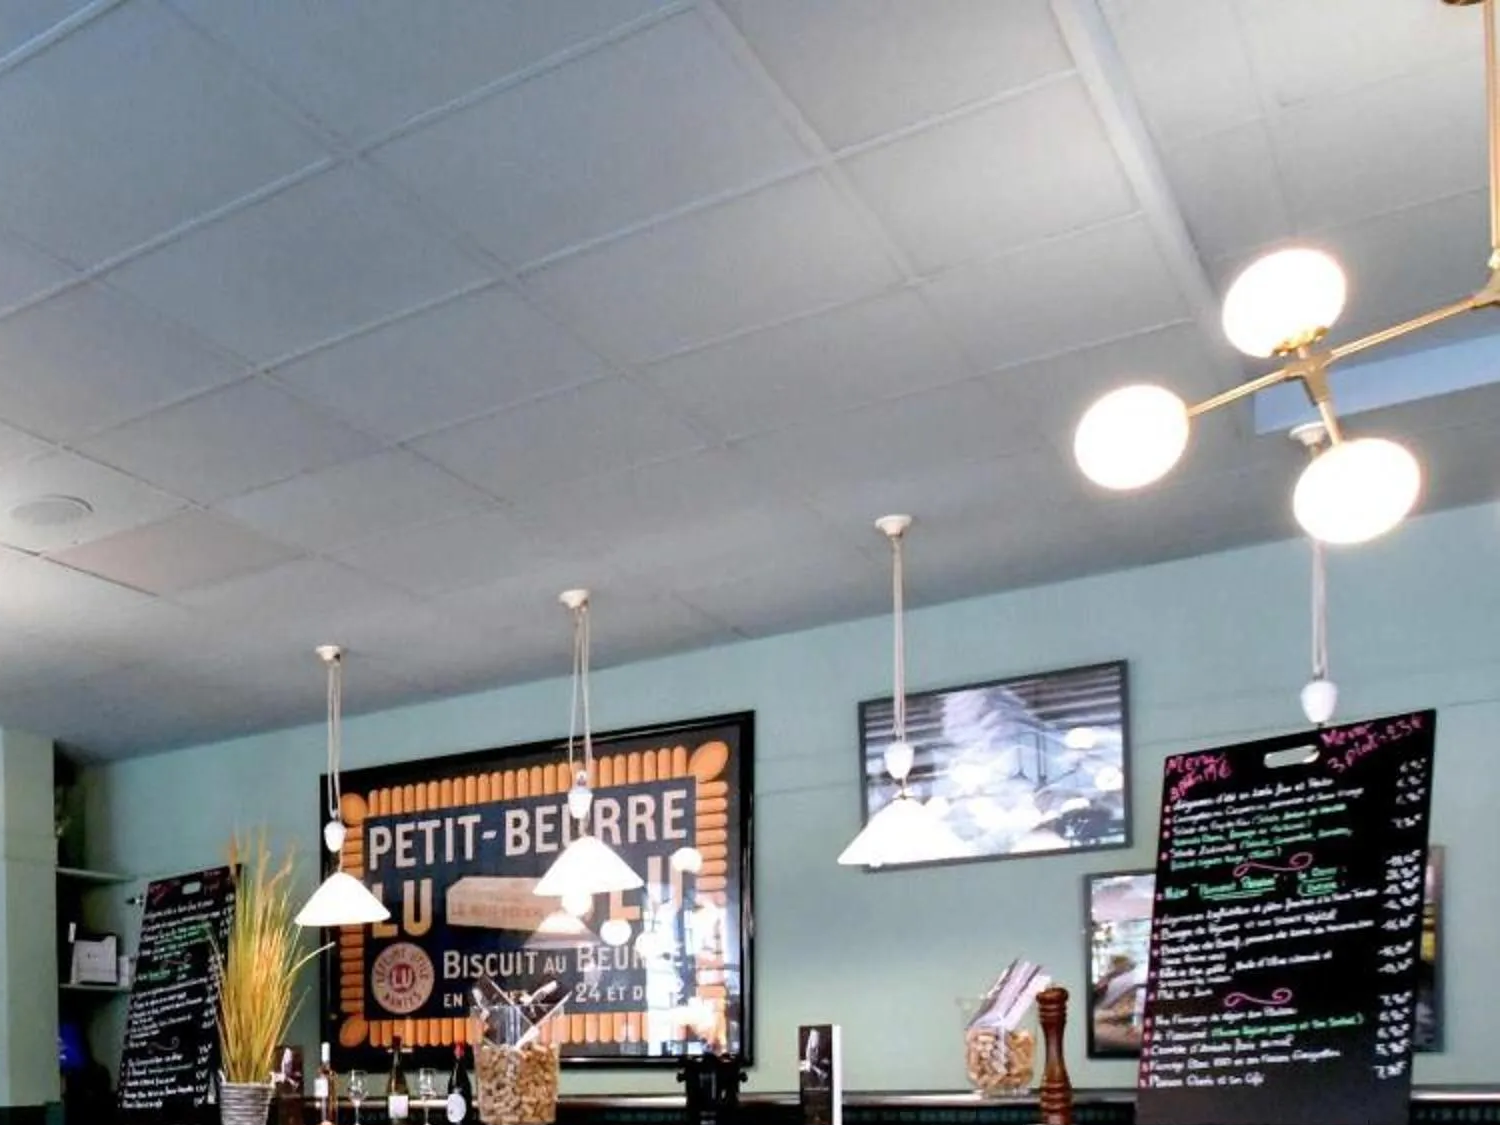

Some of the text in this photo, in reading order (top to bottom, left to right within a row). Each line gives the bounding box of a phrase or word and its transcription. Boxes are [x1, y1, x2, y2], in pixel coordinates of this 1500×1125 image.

[543, 955, 567, 975] AU
[443, 992, 464, 1008] EN
[575, 981, 601, 1004] 24
